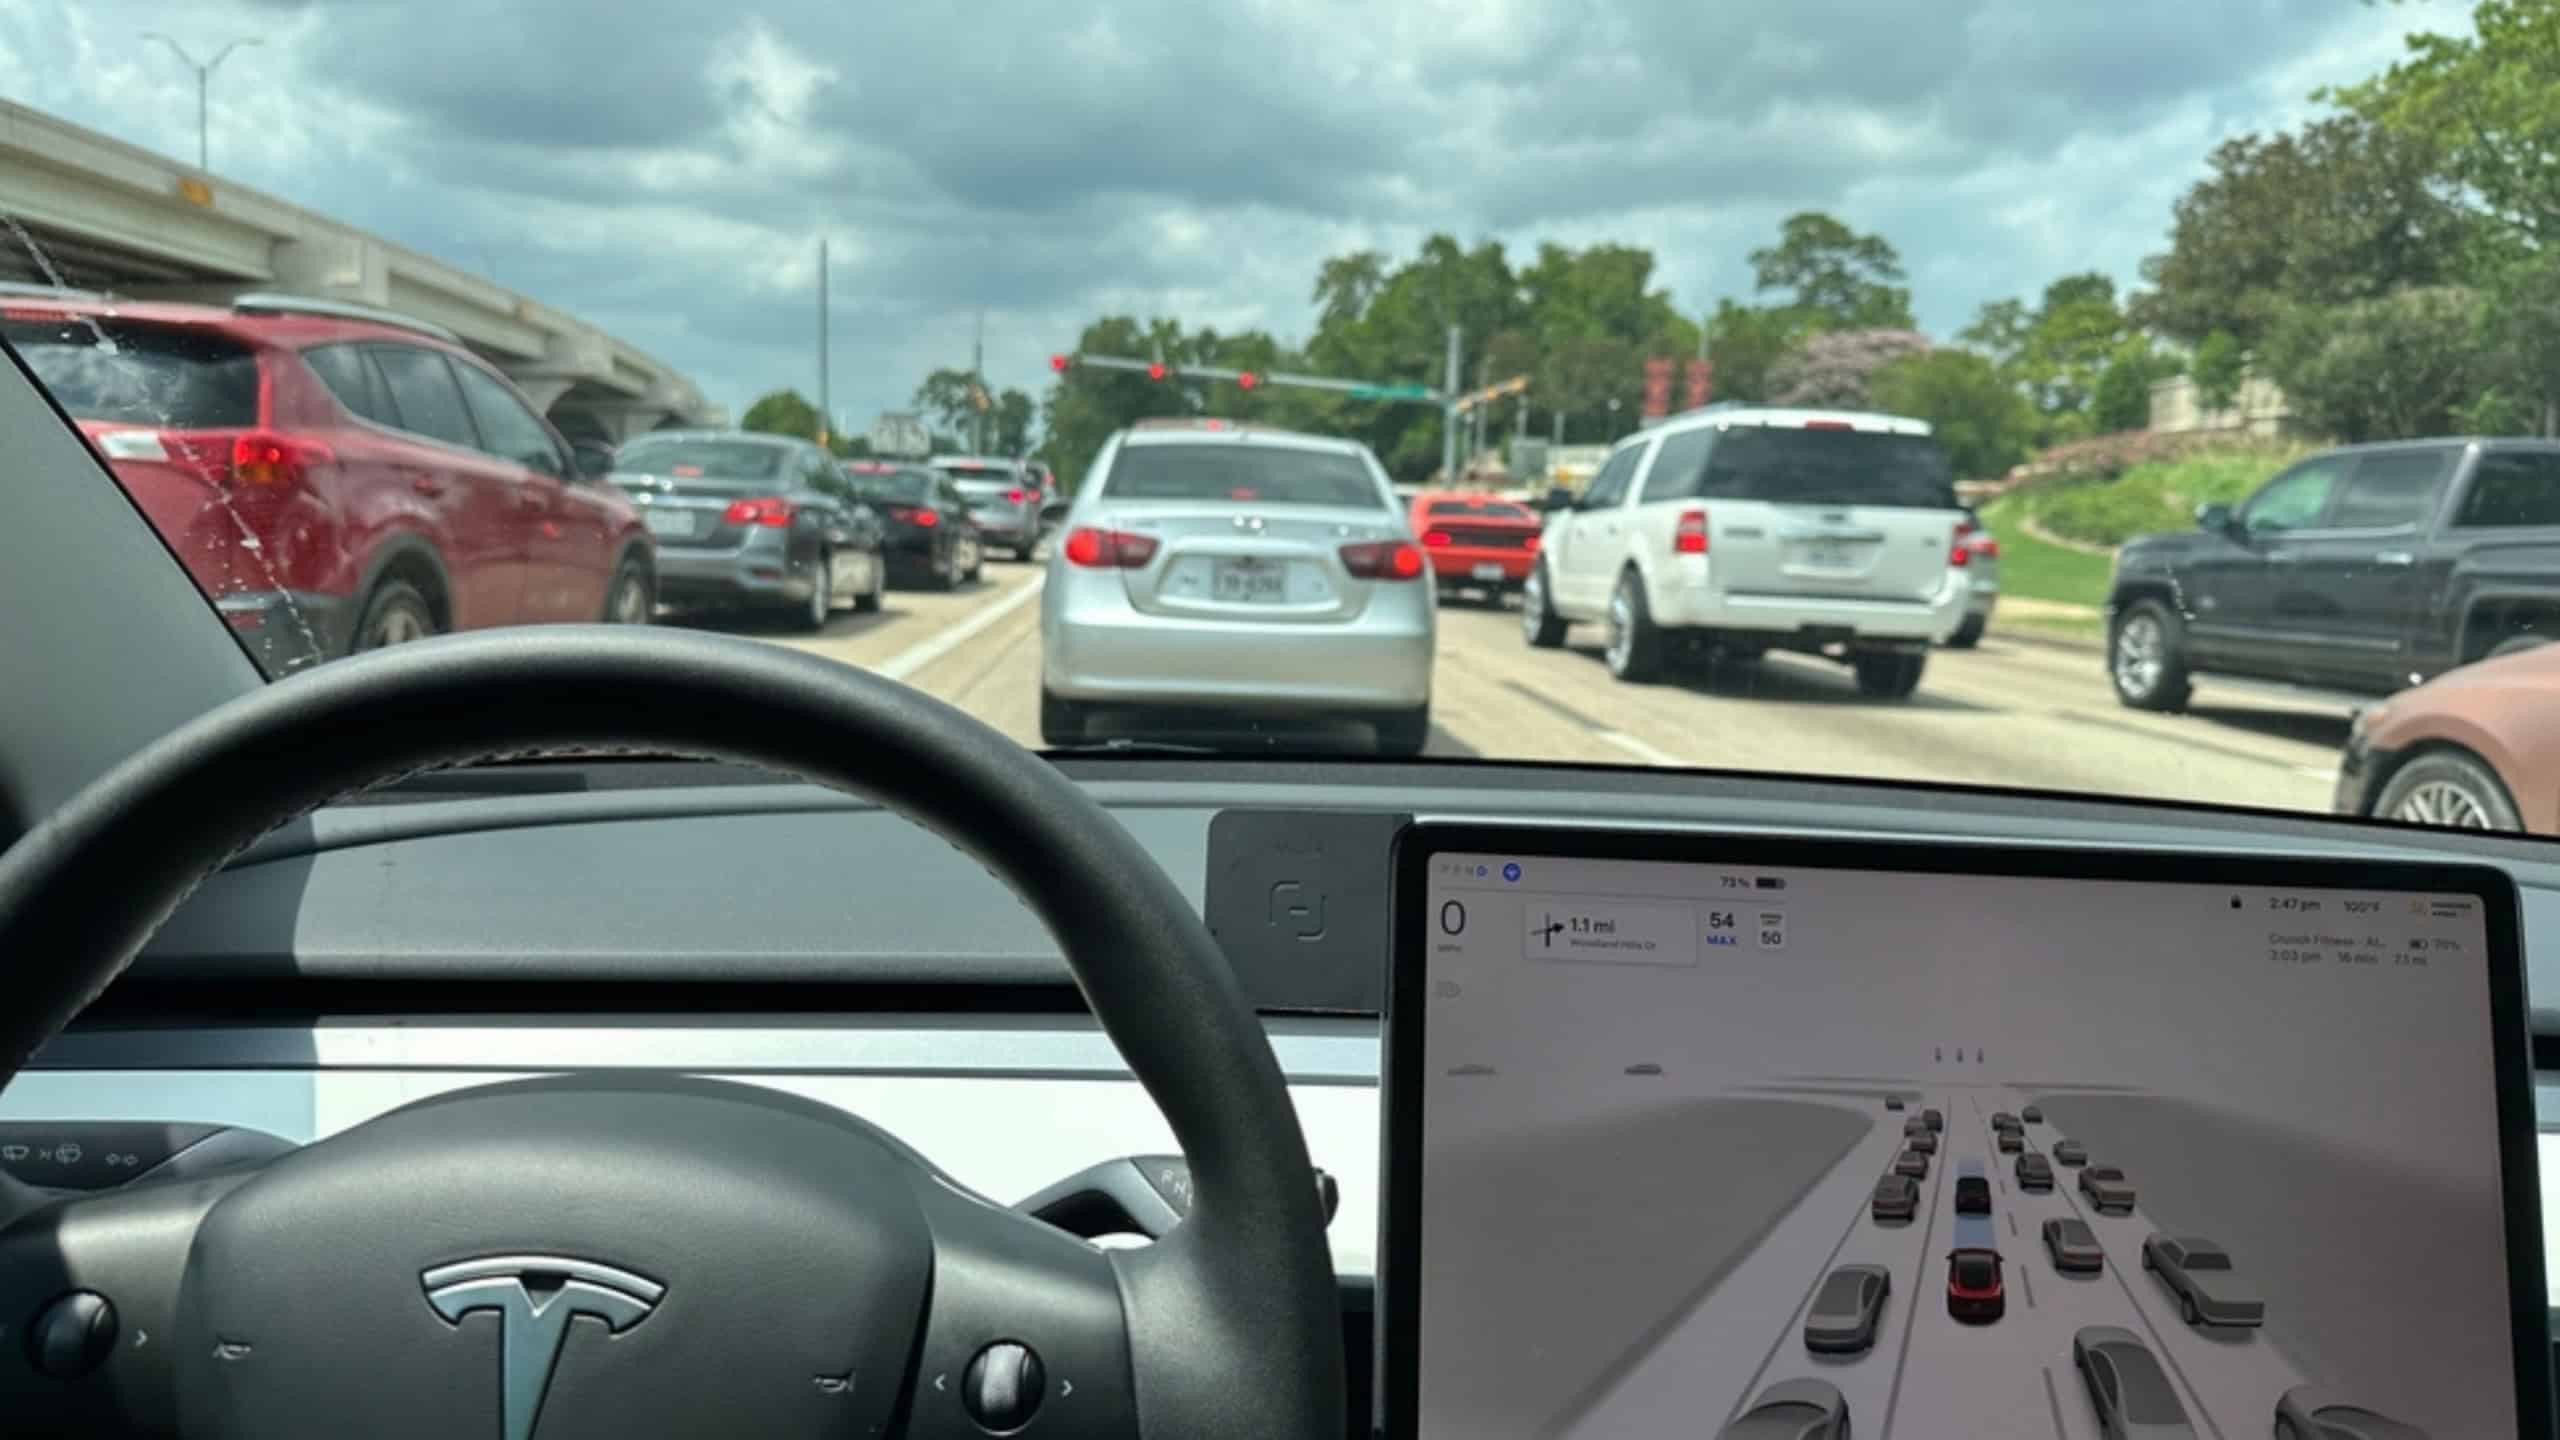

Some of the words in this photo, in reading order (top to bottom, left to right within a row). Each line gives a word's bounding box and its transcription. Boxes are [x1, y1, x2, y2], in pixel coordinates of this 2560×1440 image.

[1440, 899, 1466, 937] 0
[1569, 917, 1590, 933] 1.1
[1593, 919, 1616, 934] mi
[1709, 911, 1735, 929] 54
[1706, 934, 1737, 945] MAX
[1761, 930, 1782, 945] 50
